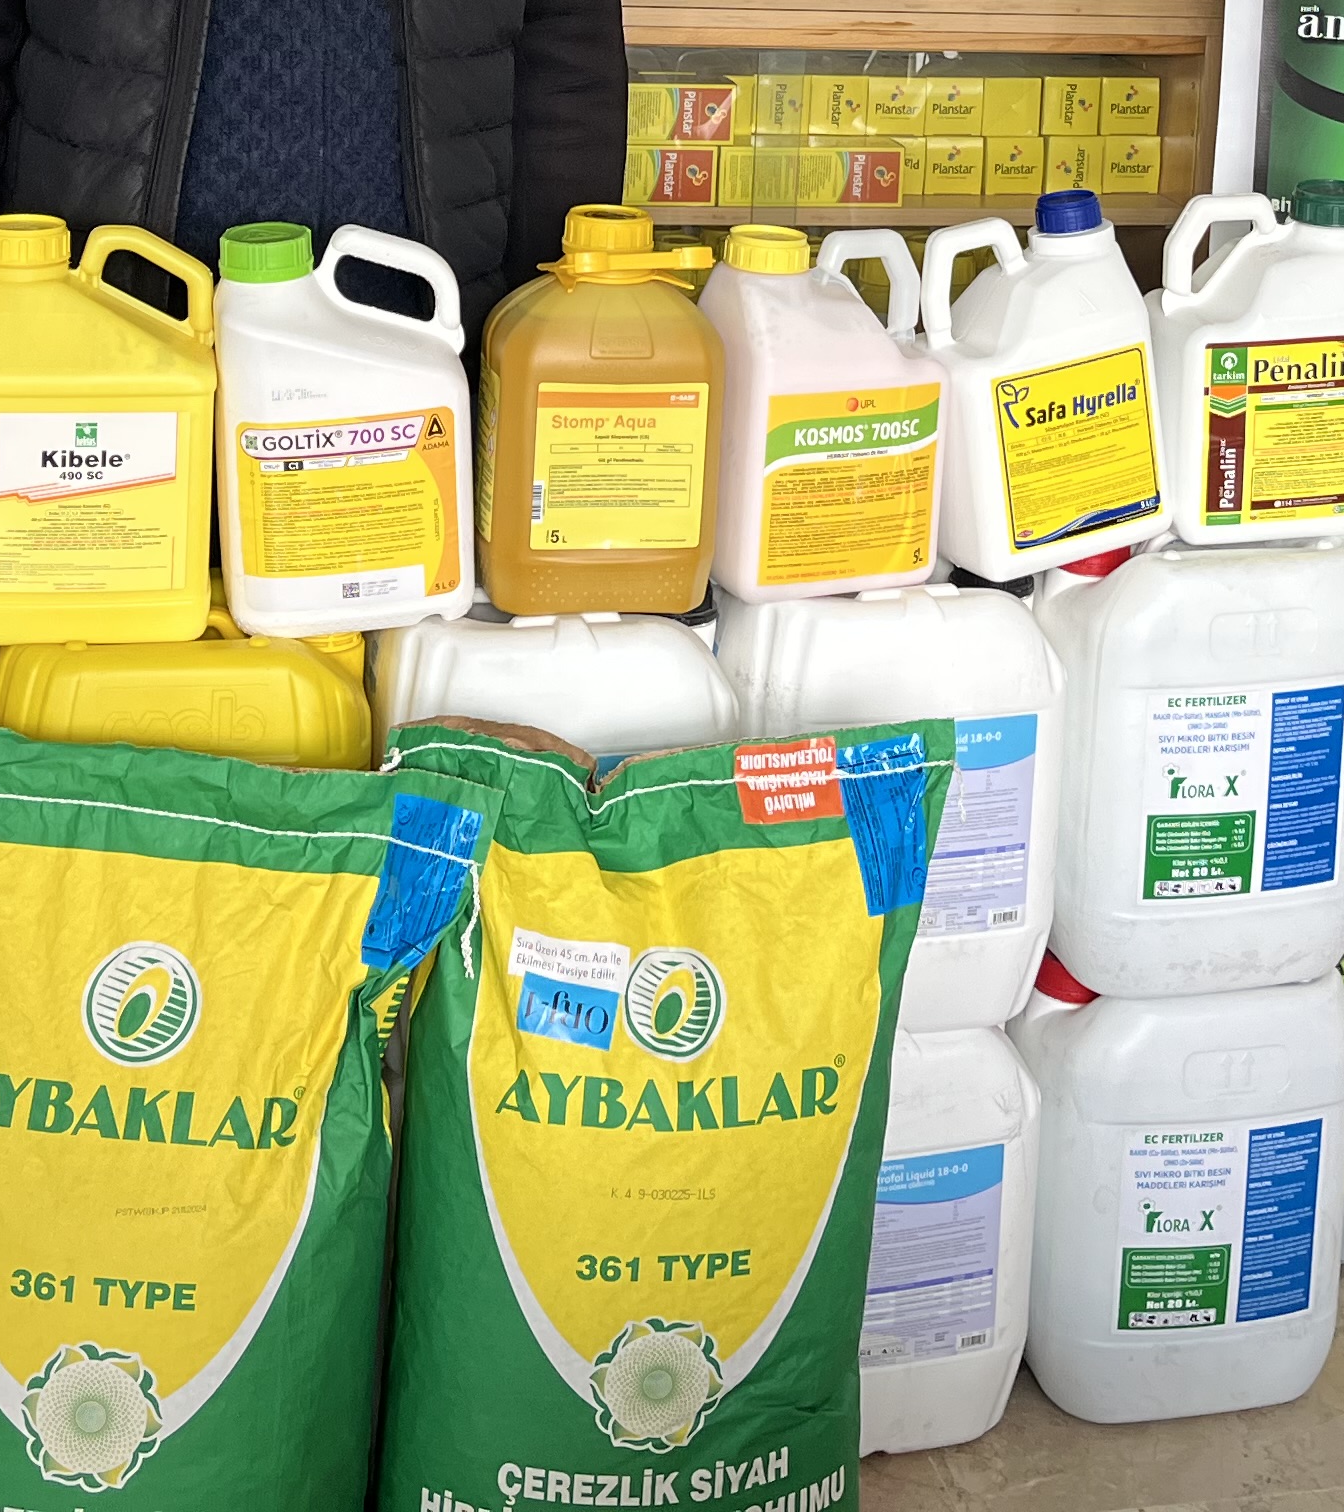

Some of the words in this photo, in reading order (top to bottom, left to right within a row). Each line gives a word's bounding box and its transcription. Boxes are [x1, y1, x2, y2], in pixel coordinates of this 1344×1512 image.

[875, 102, 918, 118] Planstar
[932, 162, 974, 178] Planstar
[1213, 371, 1246, 383] tarkim
[860, 400, 876, 409] UPL
[1026, 404, 1067, 427] Safa
[1072, 384, 1137, 417] Hyrella
[613, 415, 657, 431] Aqua
[349, 429, 384, 446] 700
[391, 424, 416, 442] SC
[794, 426, 864, 446] KOSMOS
[871, 419, 920, 442] 700SC
[422, 440, 450, 451] ADAMA
[41, 450, 123, 469] Kibele
[59, 471, 81, 481] 490
[86, 470, 104, 481] SC
[1219, 448, 1236, 508] Penalin
[550, 530, 560, 544] 5
[1168, 697, 1182, 707] EC
[1185, 695, 1247, 706] FERTILIZER
[560, 947, 572, 960] 45
[592, 952, 608, 964] Ara
[496, 1065, 839, 1133] AYBAKLAR
[1144, 1135, 1158, 1144] EC
[1162, 1132, 1224, 1144] FERTILIZER
[575, 1254, 639, 1284] 361
[657, 1248, 752, 1282] TYPE
[10, 1269, 76, 1303] 361
[93, 1277, 197, 1311] TYPE
[497, 1462, 679, 1506] ÇEREZLİK
[689, 1446, 790, 1501] SİYAH
